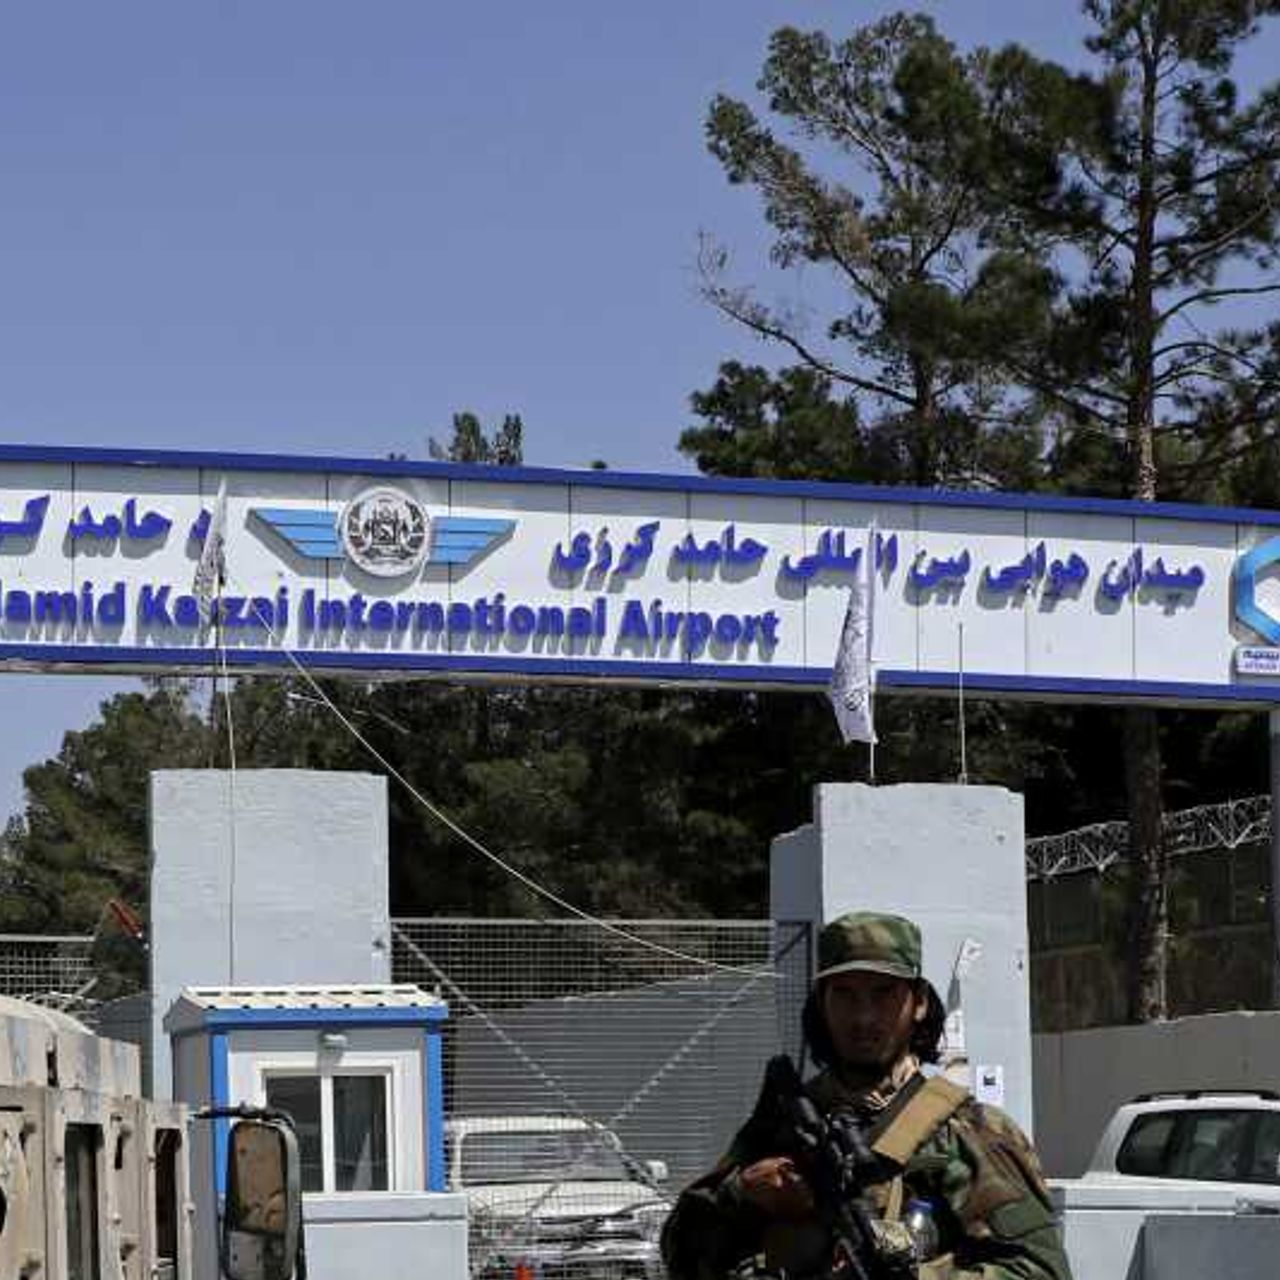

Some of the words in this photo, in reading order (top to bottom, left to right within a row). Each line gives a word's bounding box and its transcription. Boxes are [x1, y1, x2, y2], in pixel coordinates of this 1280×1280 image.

[68, 498, 172, 546] حامد
[673, 520, 769, 571] حامد
[300, 588, 607, 638] International
[622, 598, 780, 656] Airport
